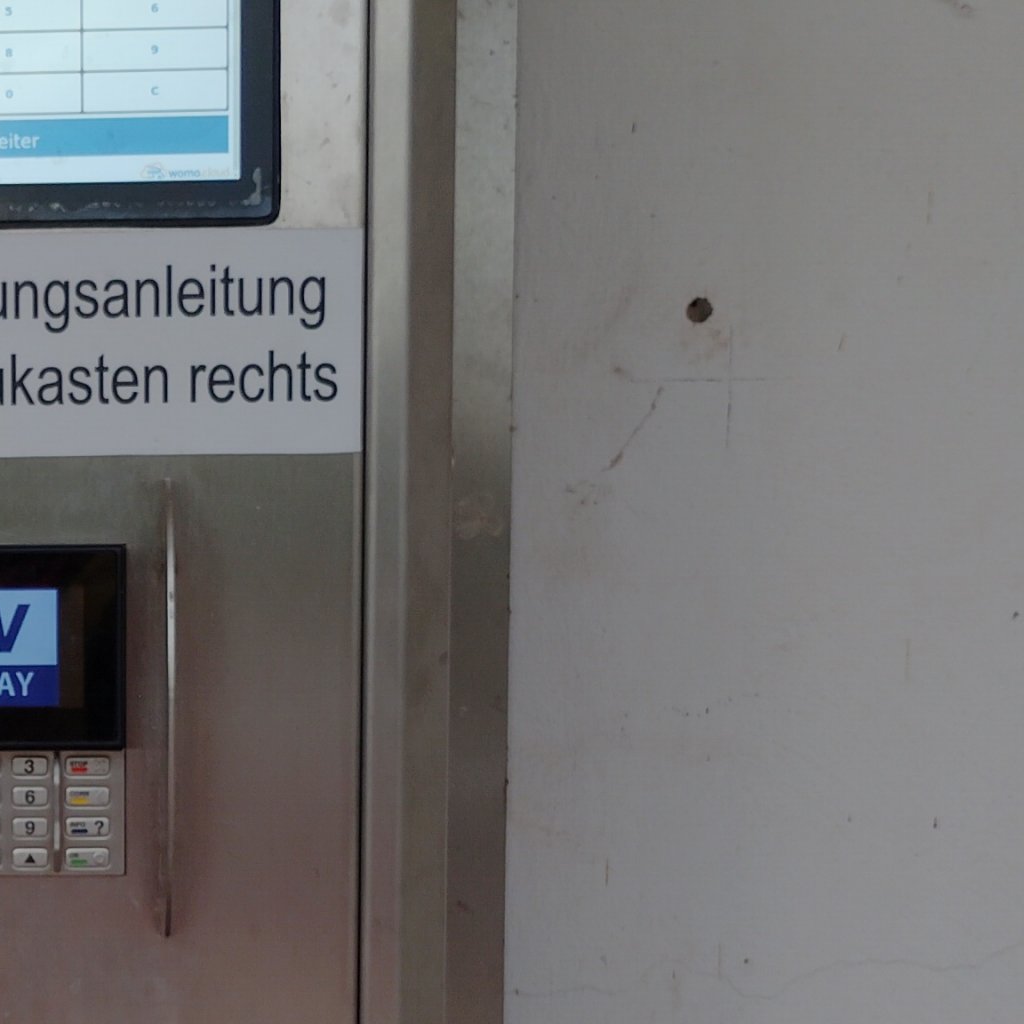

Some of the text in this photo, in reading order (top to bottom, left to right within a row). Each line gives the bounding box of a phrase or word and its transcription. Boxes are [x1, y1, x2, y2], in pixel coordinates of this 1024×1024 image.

[4, 6, 13, 17] 5
[151, 3, 159, 14] 6
[5, 47, 13, 58] 8
[150, 44, 159, 55] 9
[188, 350, 339, 404] rechts
[24, 759, 34, 774] 3
[25, 790, 35, 805] 6
[25, 821, 35, 836] 9
